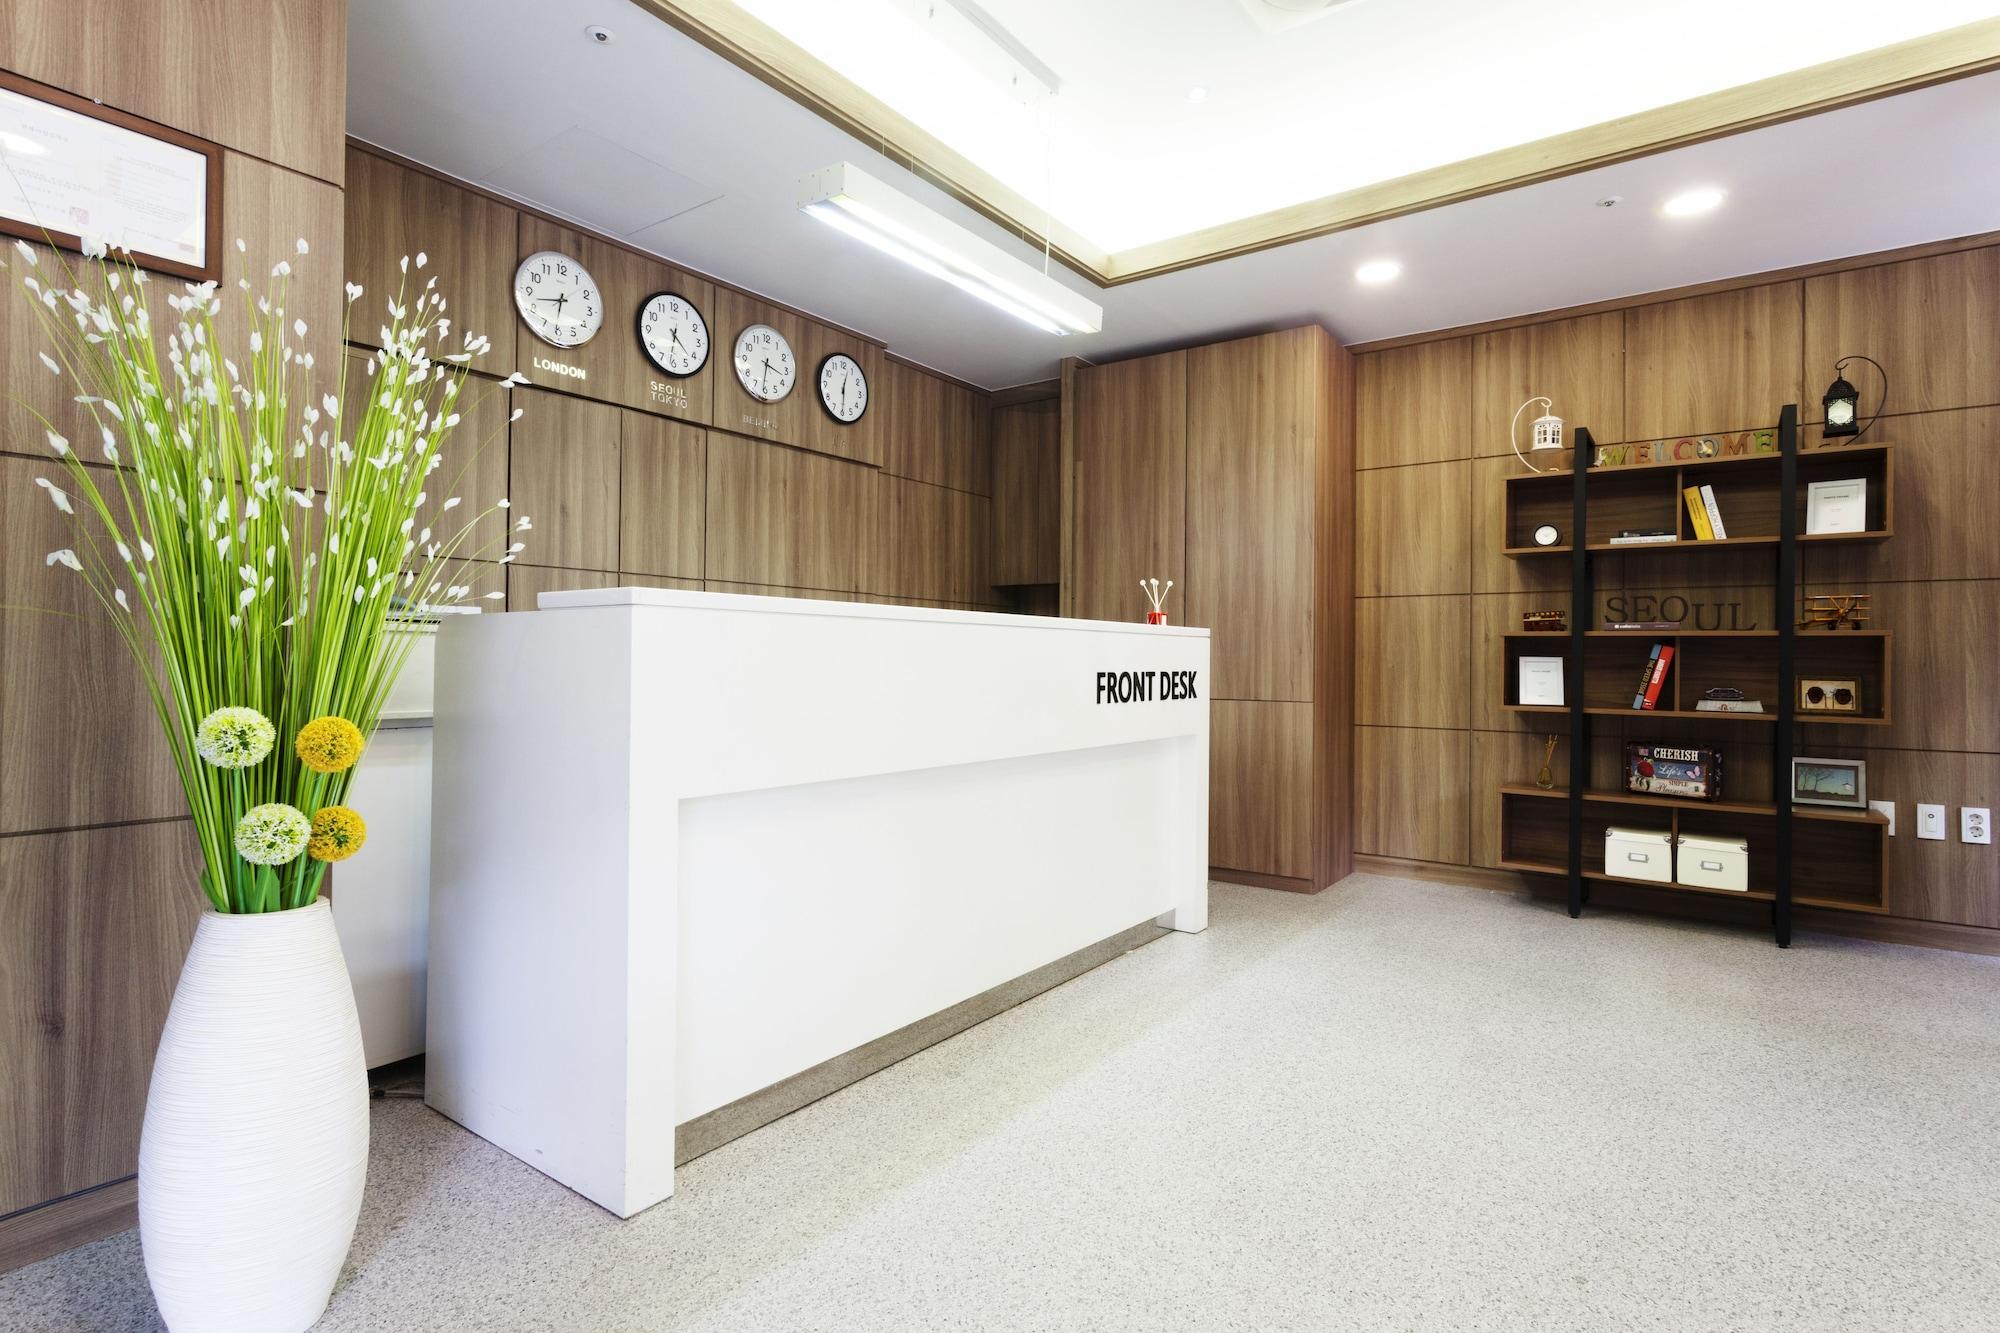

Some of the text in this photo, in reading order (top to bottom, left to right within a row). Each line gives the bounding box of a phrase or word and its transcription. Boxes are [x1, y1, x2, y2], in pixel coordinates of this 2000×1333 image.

[542, 263, 551, 275] 11
[556, 263, 568, 276] 12
[530, 272, 541, 284] 10
[575, 275, 579, 286] 1
[526, 286, 533, 296] 9
[583, 289, 590, 300] 2
[586, 306, 593, 317] 3
[658, 302, 665, 313] 11
[670, 302, 679, 313] 12
[649, 311, 658, 322] 10
[684, 310, 688, 320] 1
[541, 317, 548, 327] 7
[554, 325, 562, 336] 6
[570, 326, 577, 337] 5
[645, 324, 652, 334] 9
[692, 323, 698, 333] 2
[696, 338, 701, 348] 3
[752, 335, 759, 344] 11
[762, 333, 771, 344] 12
[745, 342, 753, 352] 10
[775, 342, 779, 350] 1
[659, 351, 665, 361] 7
[691, 351, 697, 360] 4
[781, 353, 787, 362] 2
[671, 358, 677, 368] 6
[683, 358, 689, 368] 5
[832, 362, 838, 370] 11
[840, 360, 847, 370] 12
[534, 357, 586, 380] LONDON
[745, 369, 750, 377] 8
[784, 367, 789, 376] 3
[825, 369, 832, 378] 10
[850, 367, 854, 376] 1
[780, 378, 785, 387] 4
[855, 378, 860, 386] 2
[650, 381, 687, 398] SEOUL
[762, 386, 768, 394] 6
[773, 385, 778, 394] 5
[858, 390, 862, 399] 3
[650, 391, 687, 408] TOKYO
[832, 402, 836, 410] 7
[840, 408, 844, 416] 6
[848, 408, 853, 416] 5
[1602, 430, 1774, 466] WELCOME
[1604, 595, 1757, 631] SEOUL
[1096, 671, 1197, 704] FRONT DESK
[1654, 747, 1699, 761] CHERISH
[1658, 763, 1682, 778] Life's
